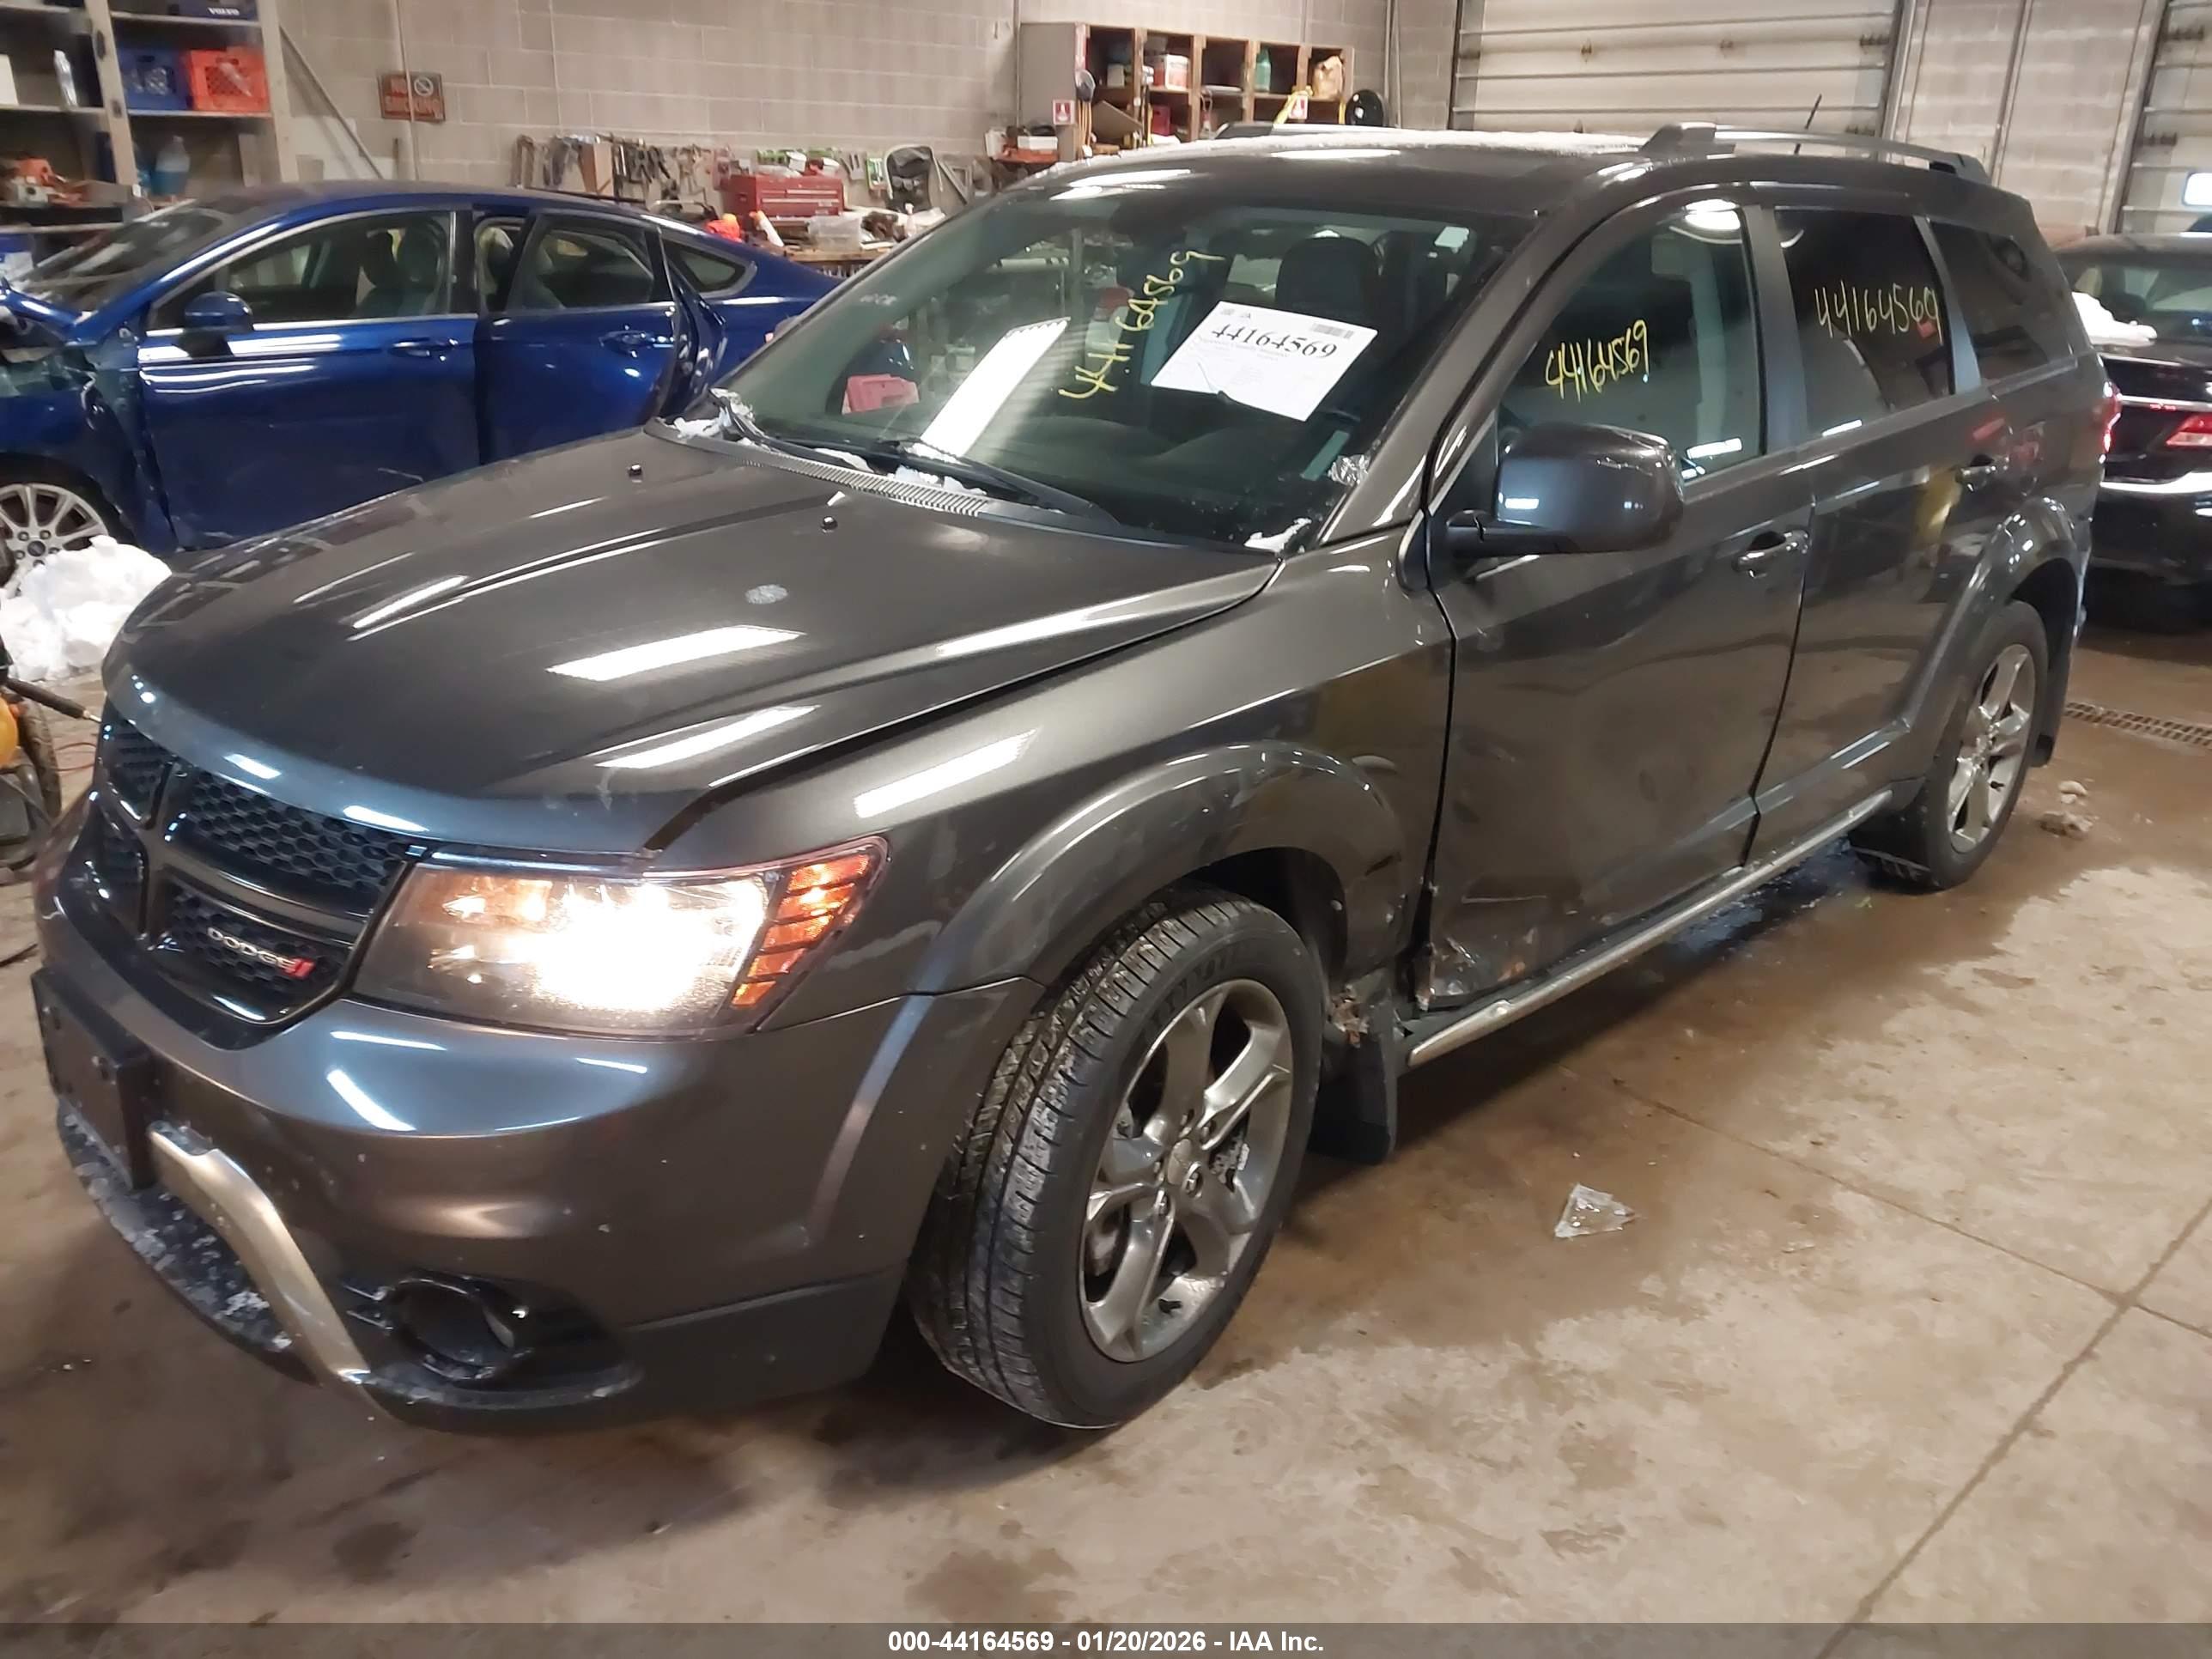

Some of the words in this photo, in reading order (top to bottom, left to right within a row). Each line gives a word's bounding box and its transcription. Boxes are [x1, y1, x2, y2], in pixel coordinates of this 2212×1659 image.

[1814, 279, 1944, 346] 44164569
[1212, 323, 1338, 359] 44164569
[1545, 319, 1650, 404] 44164569
[207, 927, 297, 973] DODGE
